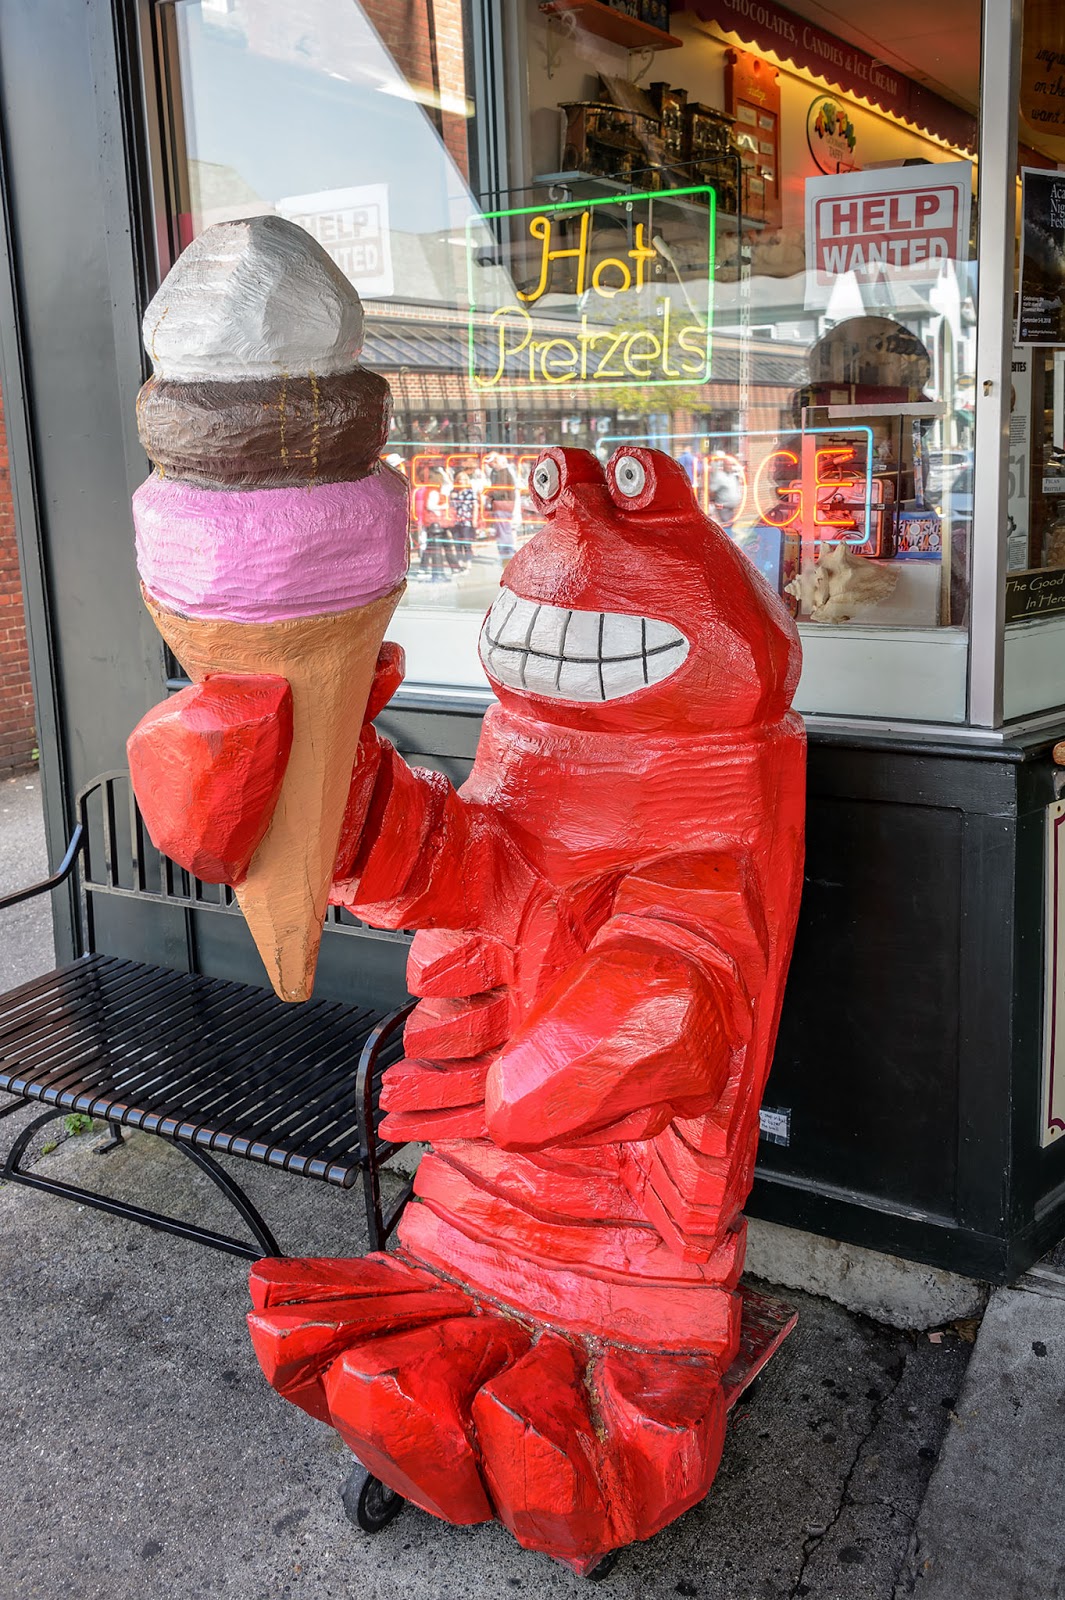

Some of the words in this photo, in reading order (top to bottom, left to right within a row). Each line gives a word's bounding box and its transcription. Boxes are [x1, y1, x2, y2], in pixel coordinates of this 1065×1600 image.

[802, 26, 844, 68] CANDIES
[844, 55, 852, 71] &
[854, 54, 868, 80] ICE
[869, 64, 898, 96] CREAM
[832, 194, 940, 236] HELP
[516, 211, 657, 301] Hot
[822, 236, 949, 278] WANTED
[474, 297, 707, 387] Pretzels
[692, 448, 856, 527] DGE
[1006, 580, 1027, 595] The
[1030, 574, 1065, 591] Good
[1025, 596, 1037, 610] In
